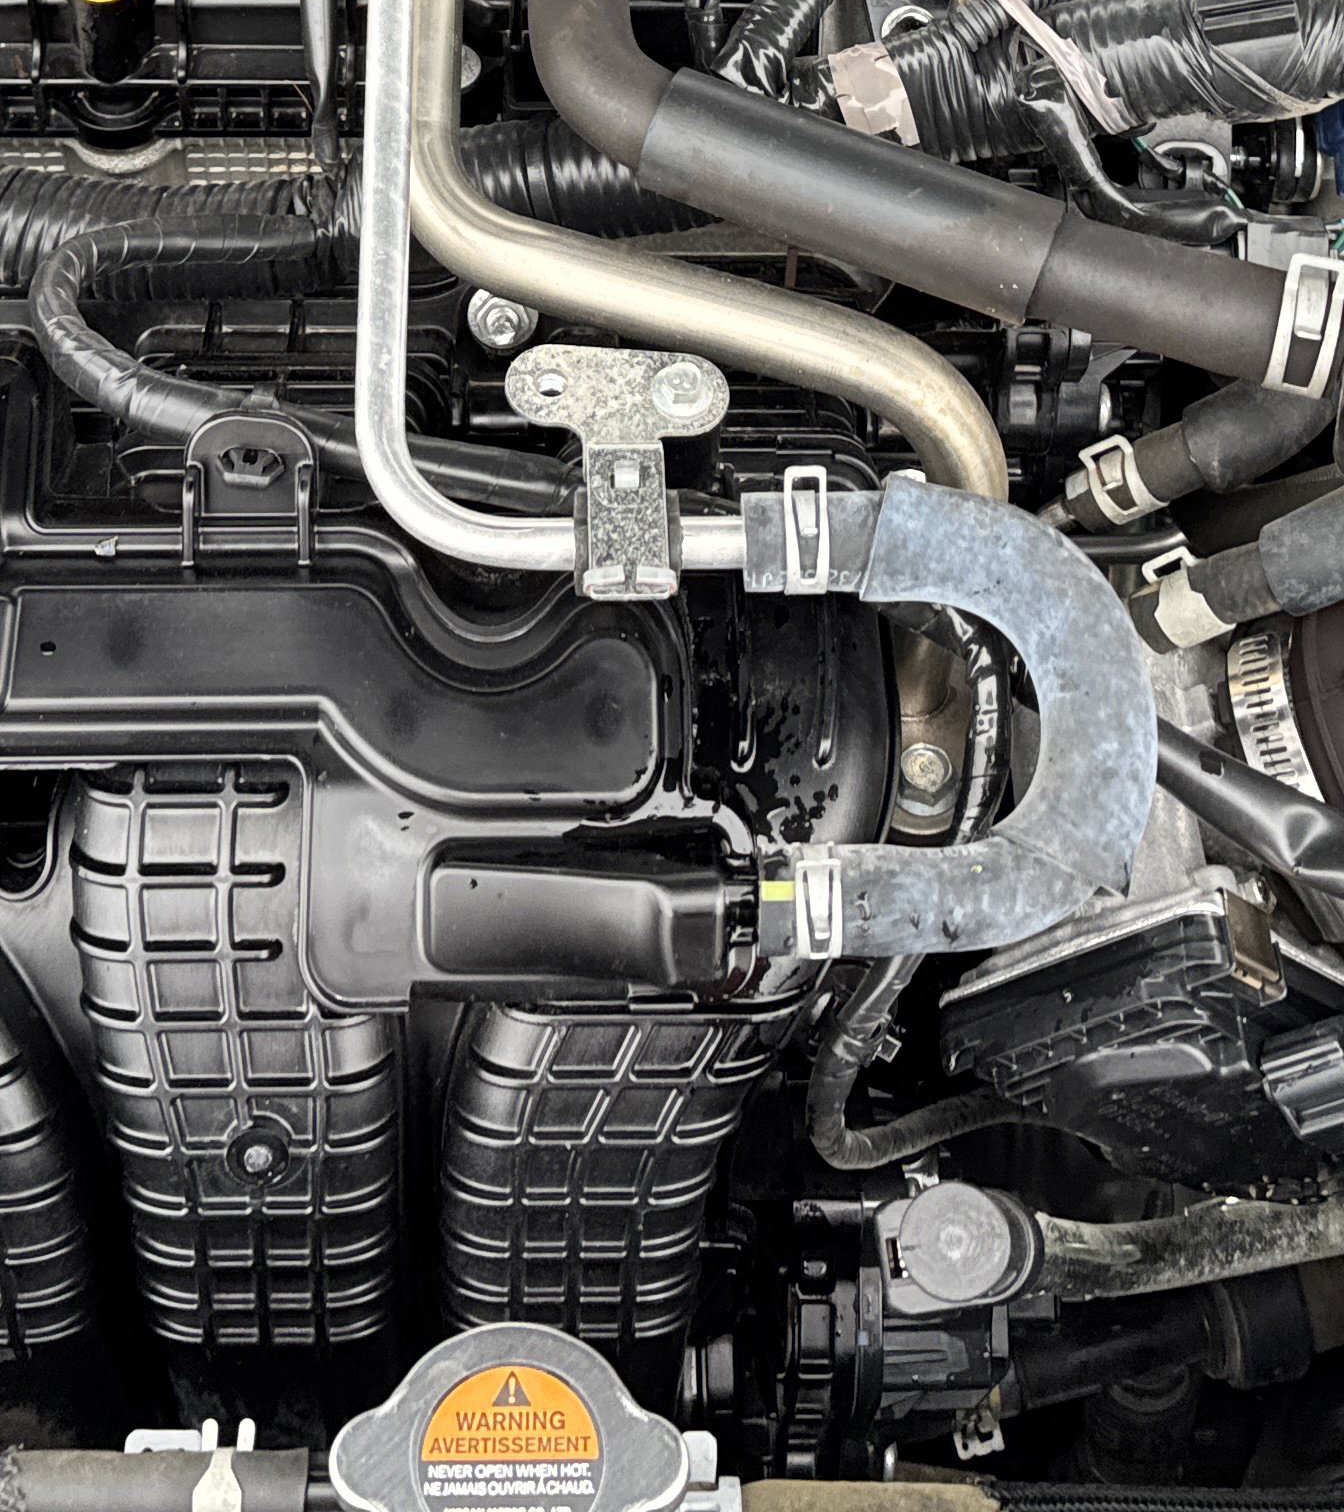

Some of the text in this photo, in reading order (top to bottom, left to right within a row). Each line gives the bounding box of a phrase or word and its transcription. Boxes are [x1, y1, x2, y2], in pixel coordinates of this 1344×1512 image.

[456, 1410, 566, 1432] WARNING
[428, 1435, 591, 1455] AVERTISSEMENT
[428, 1462, 592, 1479] NEVER OPEN WHEN HOT.
[423, 1481, 442, 1496] NE
[442, 1481, 487, 1496] JAMAIS
[487, 1481, 536, 1495] OUVRIR
